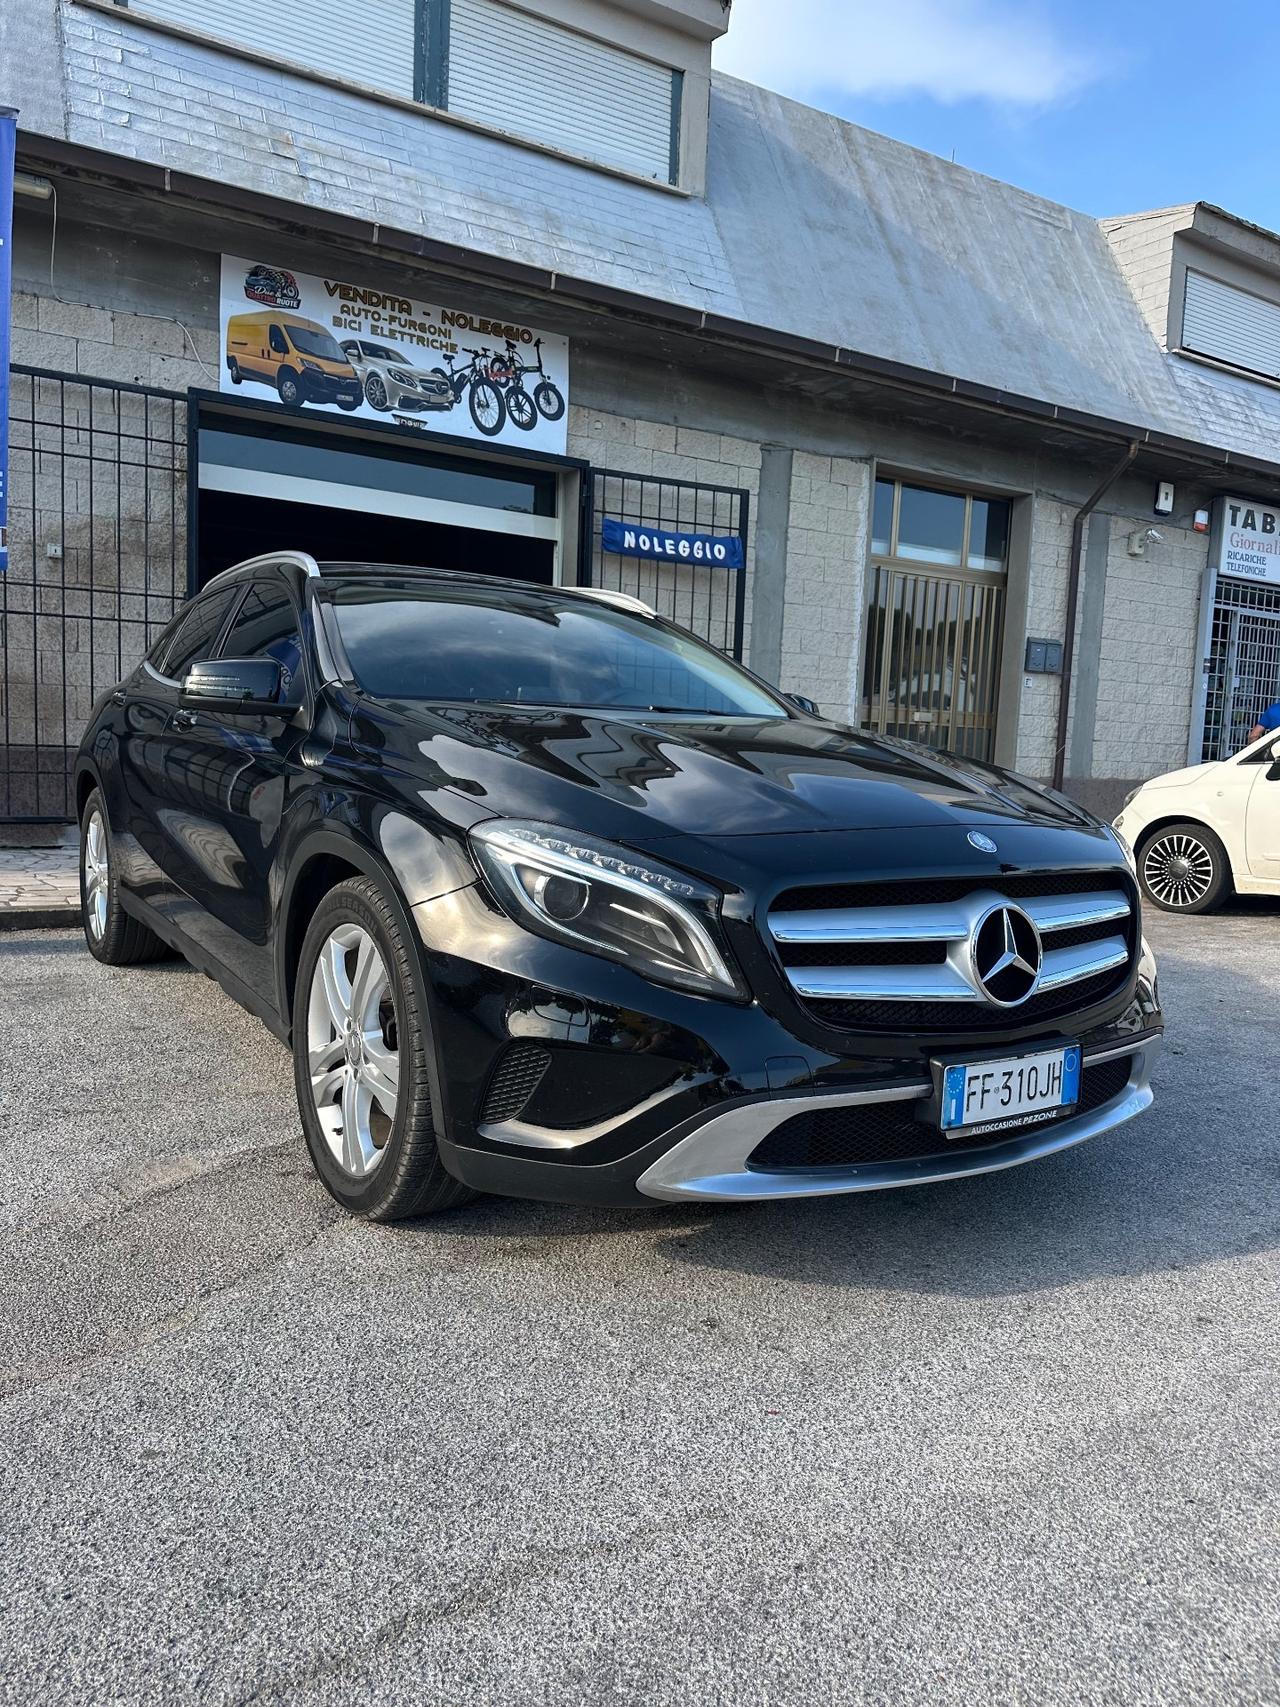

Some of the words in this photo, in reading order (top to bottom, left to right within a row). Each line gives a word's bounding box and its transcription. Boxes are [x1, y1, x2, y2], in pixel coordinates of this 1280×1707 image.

[276, 298, 298, 308] RUOTE
[323, 280, 412, 316] VENDITA
[441, 310, 533, 344] NOLEGGIO
[332, 316, 363, 333] BICI
[370, 324, 459, 355] ELETTRICHE
[339, 303, 452, 340] AUTO-FURGONI
[1229, 505, 1280, 537] TAB
[623, 531, 726, 560] NOLEGGIO
[1227, 550, 1267, 566] RICARICHE
[1226, 561, 1267, 577] TELEFONICHE
[970, 1118, 1022, 1135] AUTOCCASIONE
[1022, 1110, 1057, 1125] PEZONE
